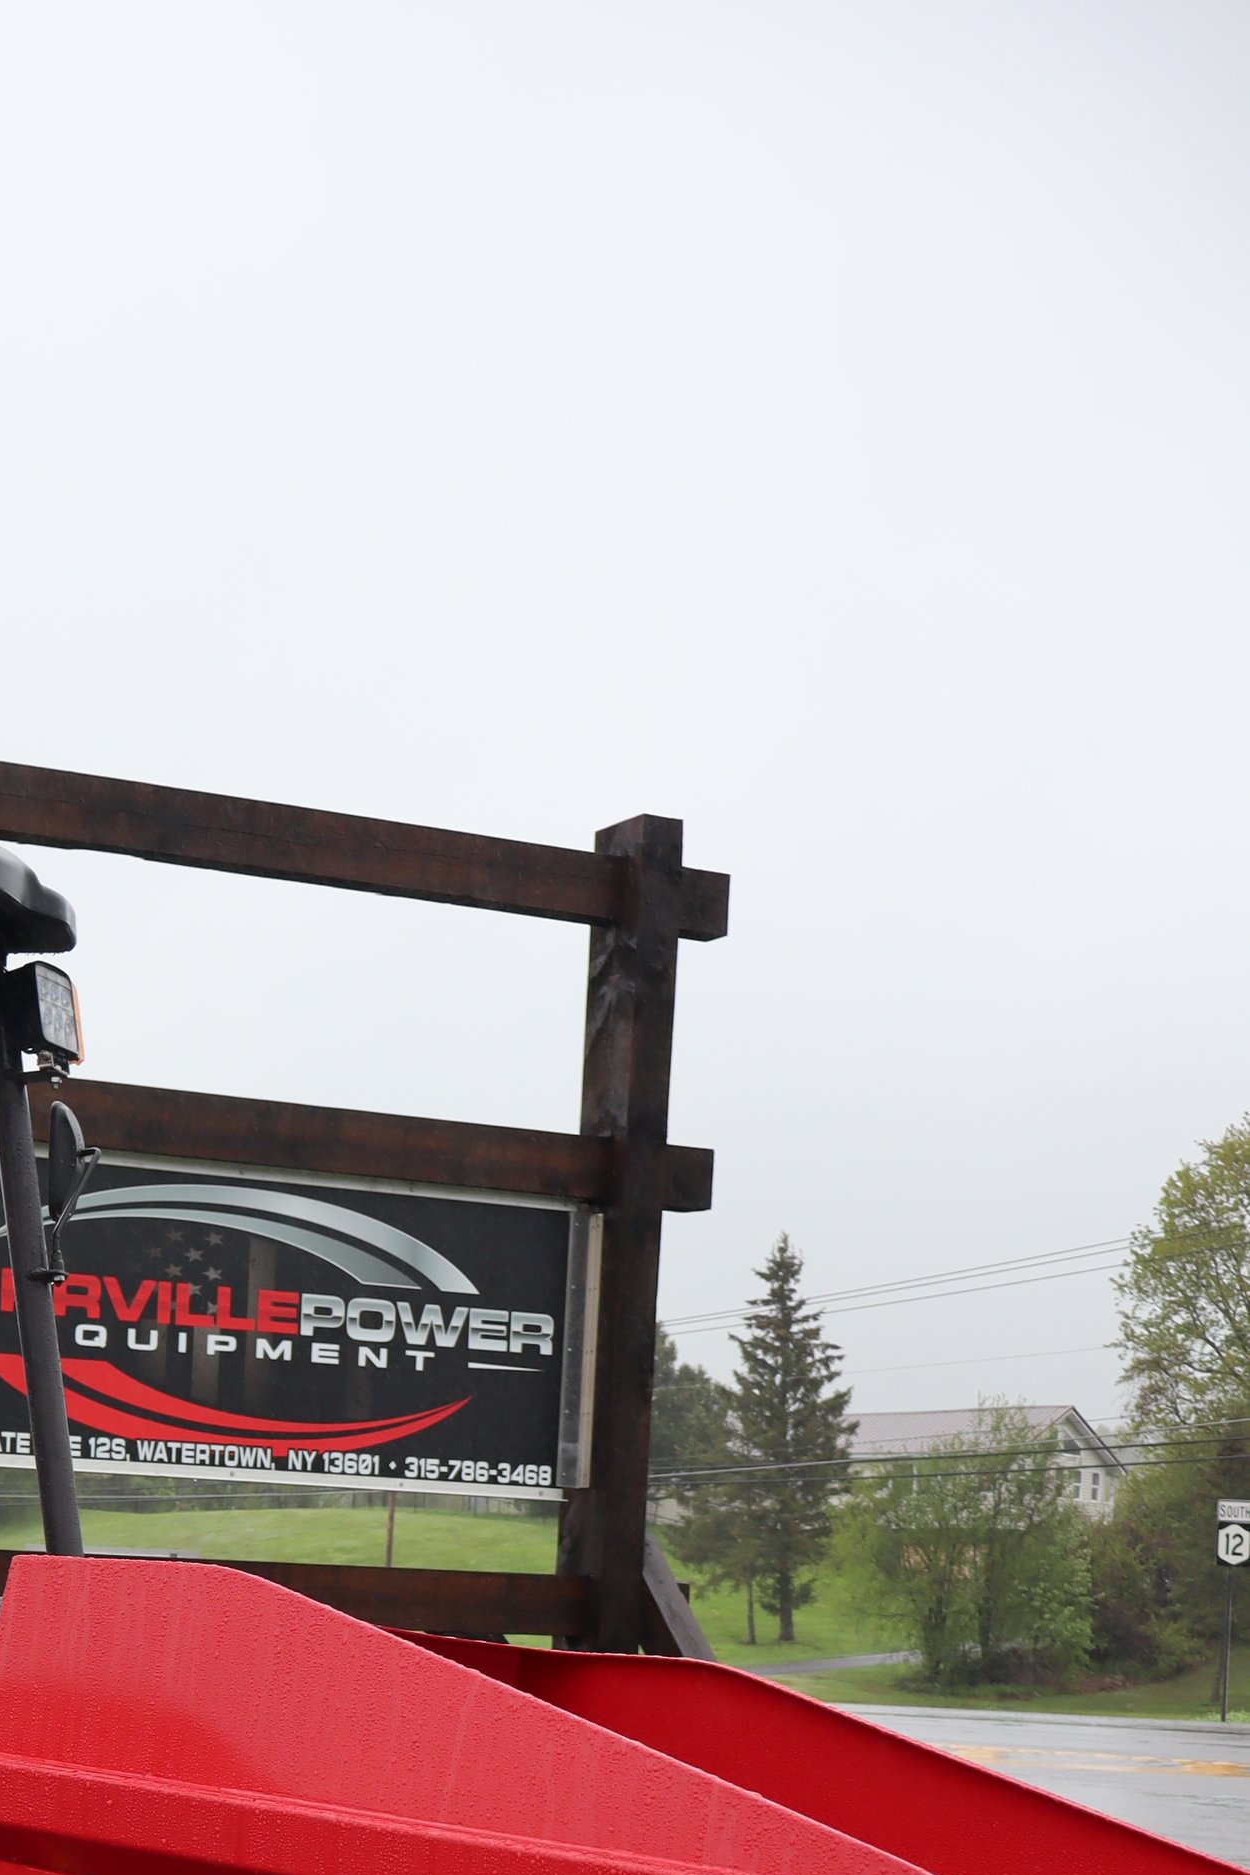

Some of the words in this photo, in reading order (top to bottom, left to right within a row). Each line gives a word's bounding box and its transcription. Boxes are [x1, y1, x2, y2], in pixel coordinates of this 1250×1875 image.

[74, 1323, 435, 1372] QUIPMENT
[136, 1440, 276, 1471] WATERTOWN,
[288, 1450, 318, 1471] NY
[322, 1452, 380, 1475] 13601
[404, 1456, 552, 1486] 315-786-3468
[1225, 1533, 1244, 1556] 12
